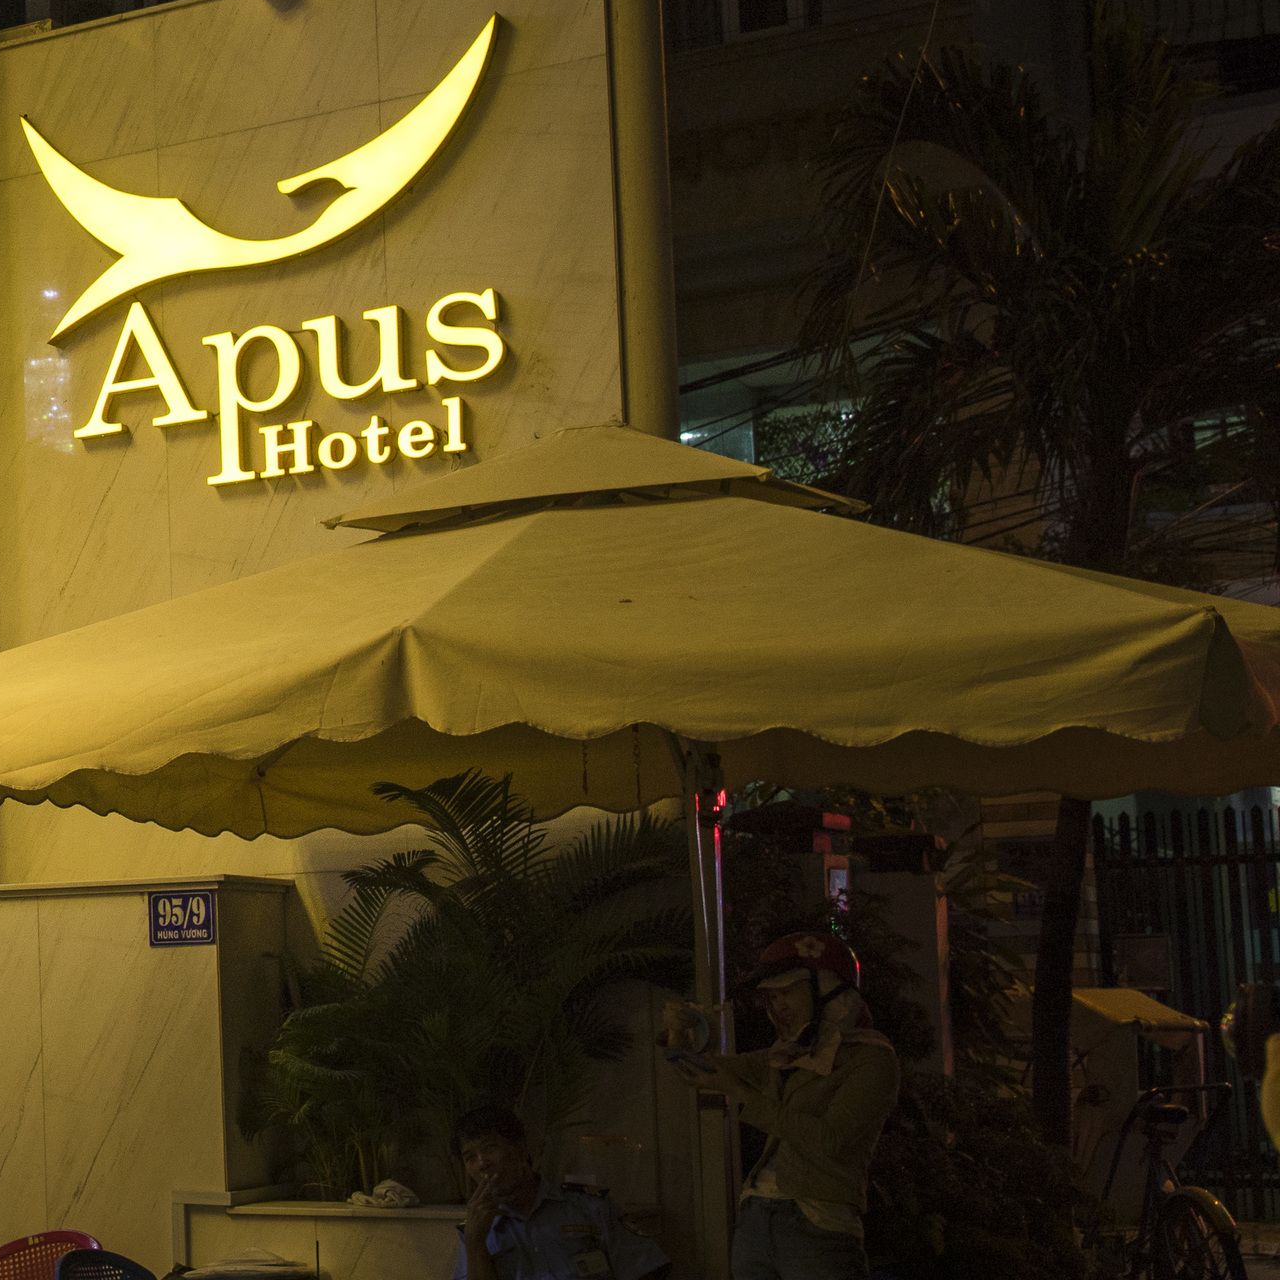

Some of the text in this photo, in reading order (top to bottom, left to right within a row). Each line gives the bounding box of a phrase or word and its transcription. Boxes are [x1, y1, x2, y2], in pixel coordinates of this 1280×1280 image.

[73, 287, 511, 487] Apus
[257, 396, 468, 480] Hotel
[157, 896, 206, 929] 95/9
